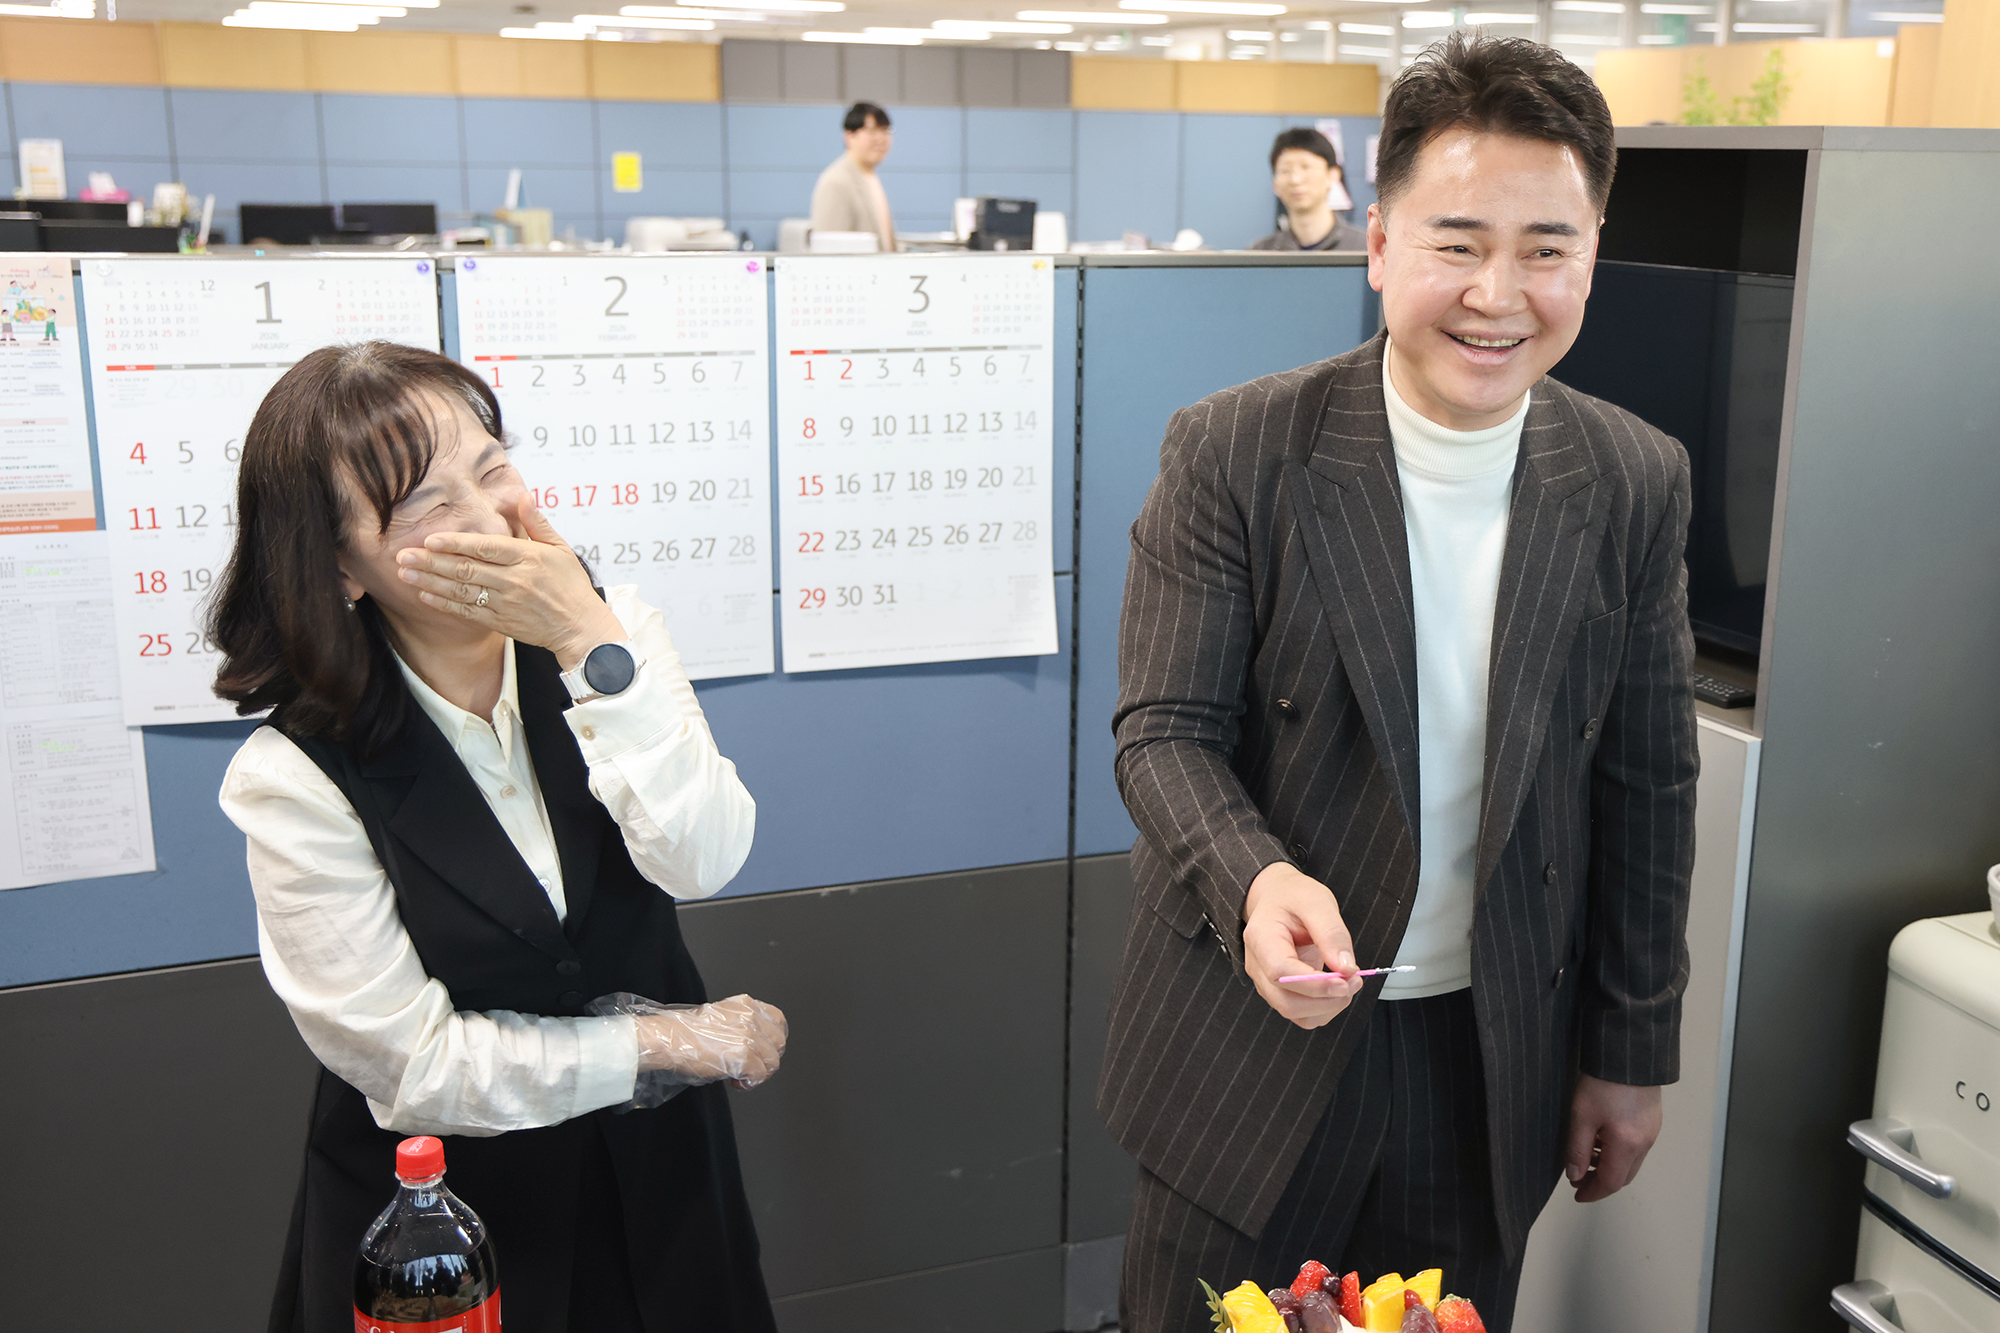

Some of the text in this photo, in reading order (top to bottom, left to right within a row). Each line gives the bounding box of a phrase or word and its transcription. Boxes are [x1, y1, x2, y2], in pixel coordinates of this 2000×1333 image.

[200, 279, 215, 291] 12
[318, 279, 325, 290] 2
[605, 275, 629, 316] 2
[908, 275, 930, 313] 3
[255, 281, 282, 323] 1
[489, 361, 743, 390] 1 2 3 4 5 6 7
[805, 354, 1031, 380] 1 2 3 4 5 6 7
[533, 419, 753, 448] 9 10 11 12 13 14
[803, 410, 1038, 438] 8 9 10 11 12 13 14
[130, 439, 242, 464] 4 5 6
[531, 478, 753, 509] 16 17 18 19 20 21
[799, 466, 1037, 496] 15 16 17 18 19 20 21
[130, 504, 237, 530] 11 12 1
[614, 543, 641, 564] 25
[653, 540, 680, 561] 26
[691, 538, 716, 559] 27
[729, 535, 755, 557] 28
[799, 520, 1037, 553] 22 23 24 25 26 27 28
[135, 569, 214, 594] 18 19
[800, 584, 897, 609] 29 30 31
[140, 634, 172, 656] 25
